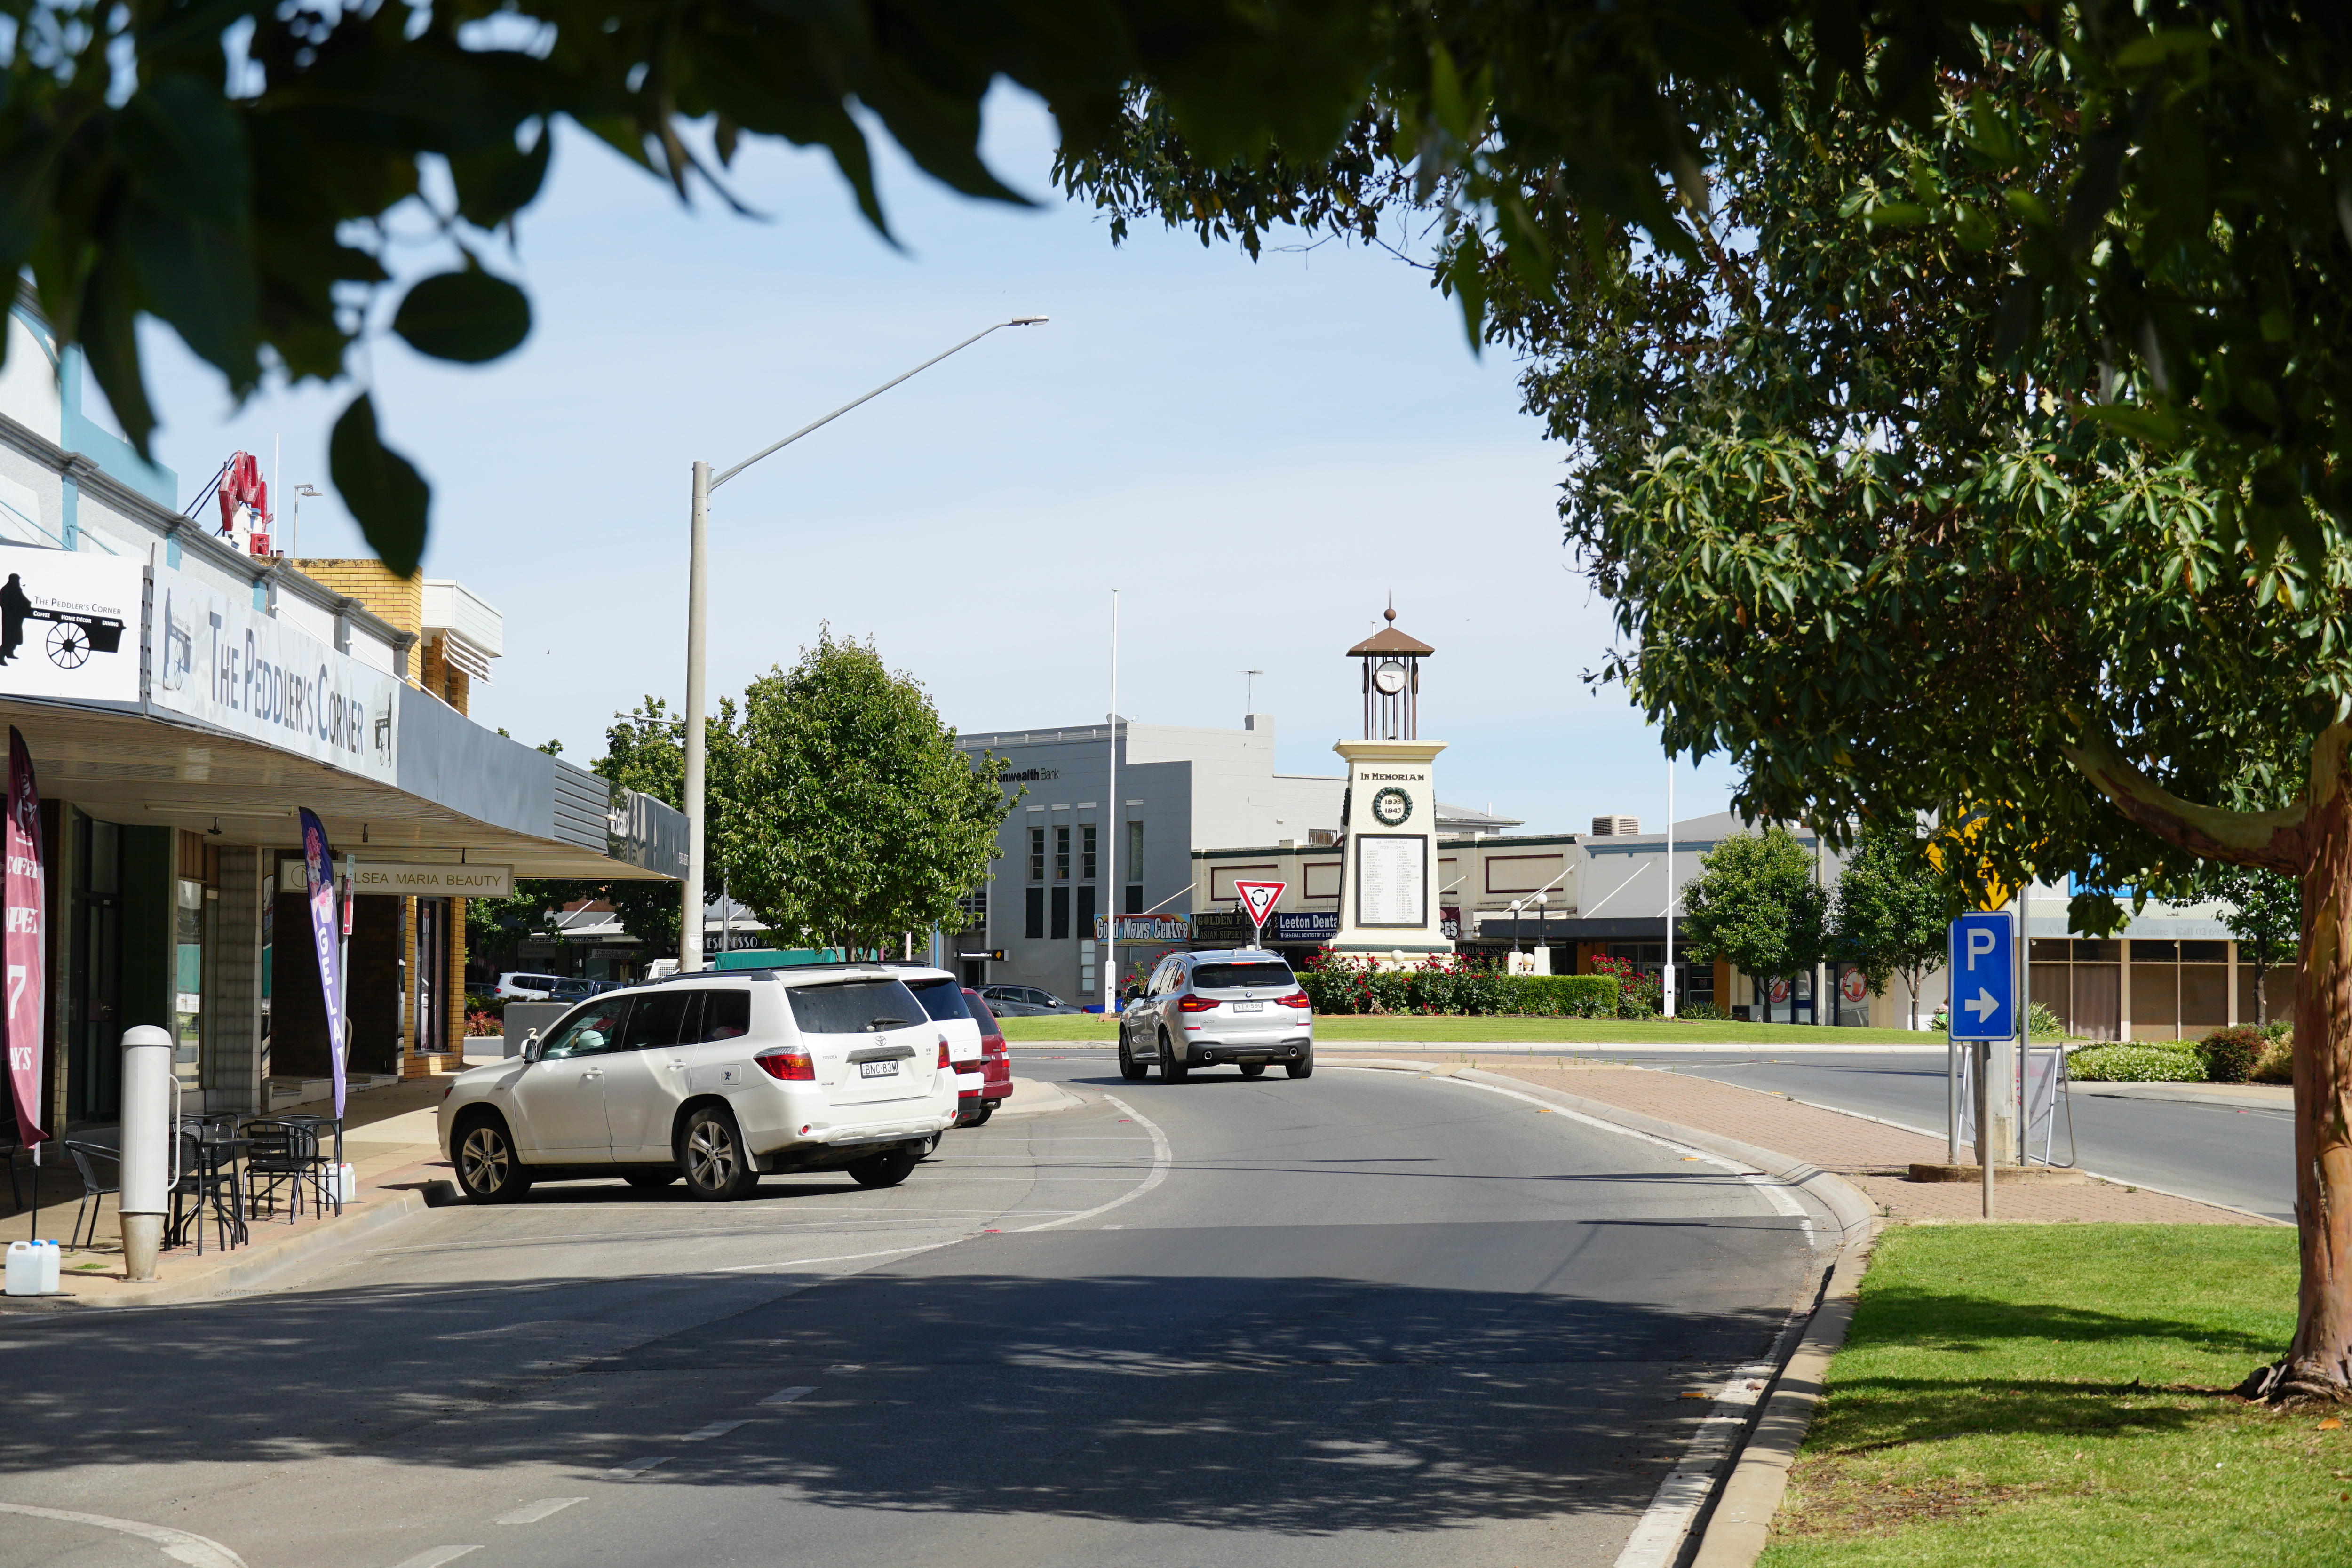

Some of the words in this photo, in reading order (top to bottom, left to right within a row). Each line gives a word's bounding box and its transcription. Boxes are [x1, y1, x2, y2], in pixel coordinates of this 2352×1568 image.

[34, 596, 49, 606] THE
[51, 598, 89, 611] PEDDLER'S
[92, 604, 121, 615] CORNER
[76, 615, 92, 623] DÉCOR
[210, 611, 239, 710] THE
[244, 628, 313, 736] PEDDLER'S
[317, 663, 363, 756] CORNER
[1041, 767, 1060, 780] Bank
[396, 873, 439, 885] MARIA
[446, 875, 501, 886] BEAUTY
[1096, 917, 1120, 939] God
[1123, 917, 1151, 939] News
[1153, 917, 1189, 939] Centre
[1197, 915, 1233, 925] GOLDEN
[1279, 915, 1310, 929] Leeton
[1312, 914, 1337, 928] Denta
[1220, 931, 1265, 939] SUPERMART
[2175, 926, 2193, 936] Call
[1967, 928, 1996, 971] P
[7, 965, 26, 1019] 7
[318, 927, 346, 1090] GELAT
[10, 1047, 32, 1070] AYS
